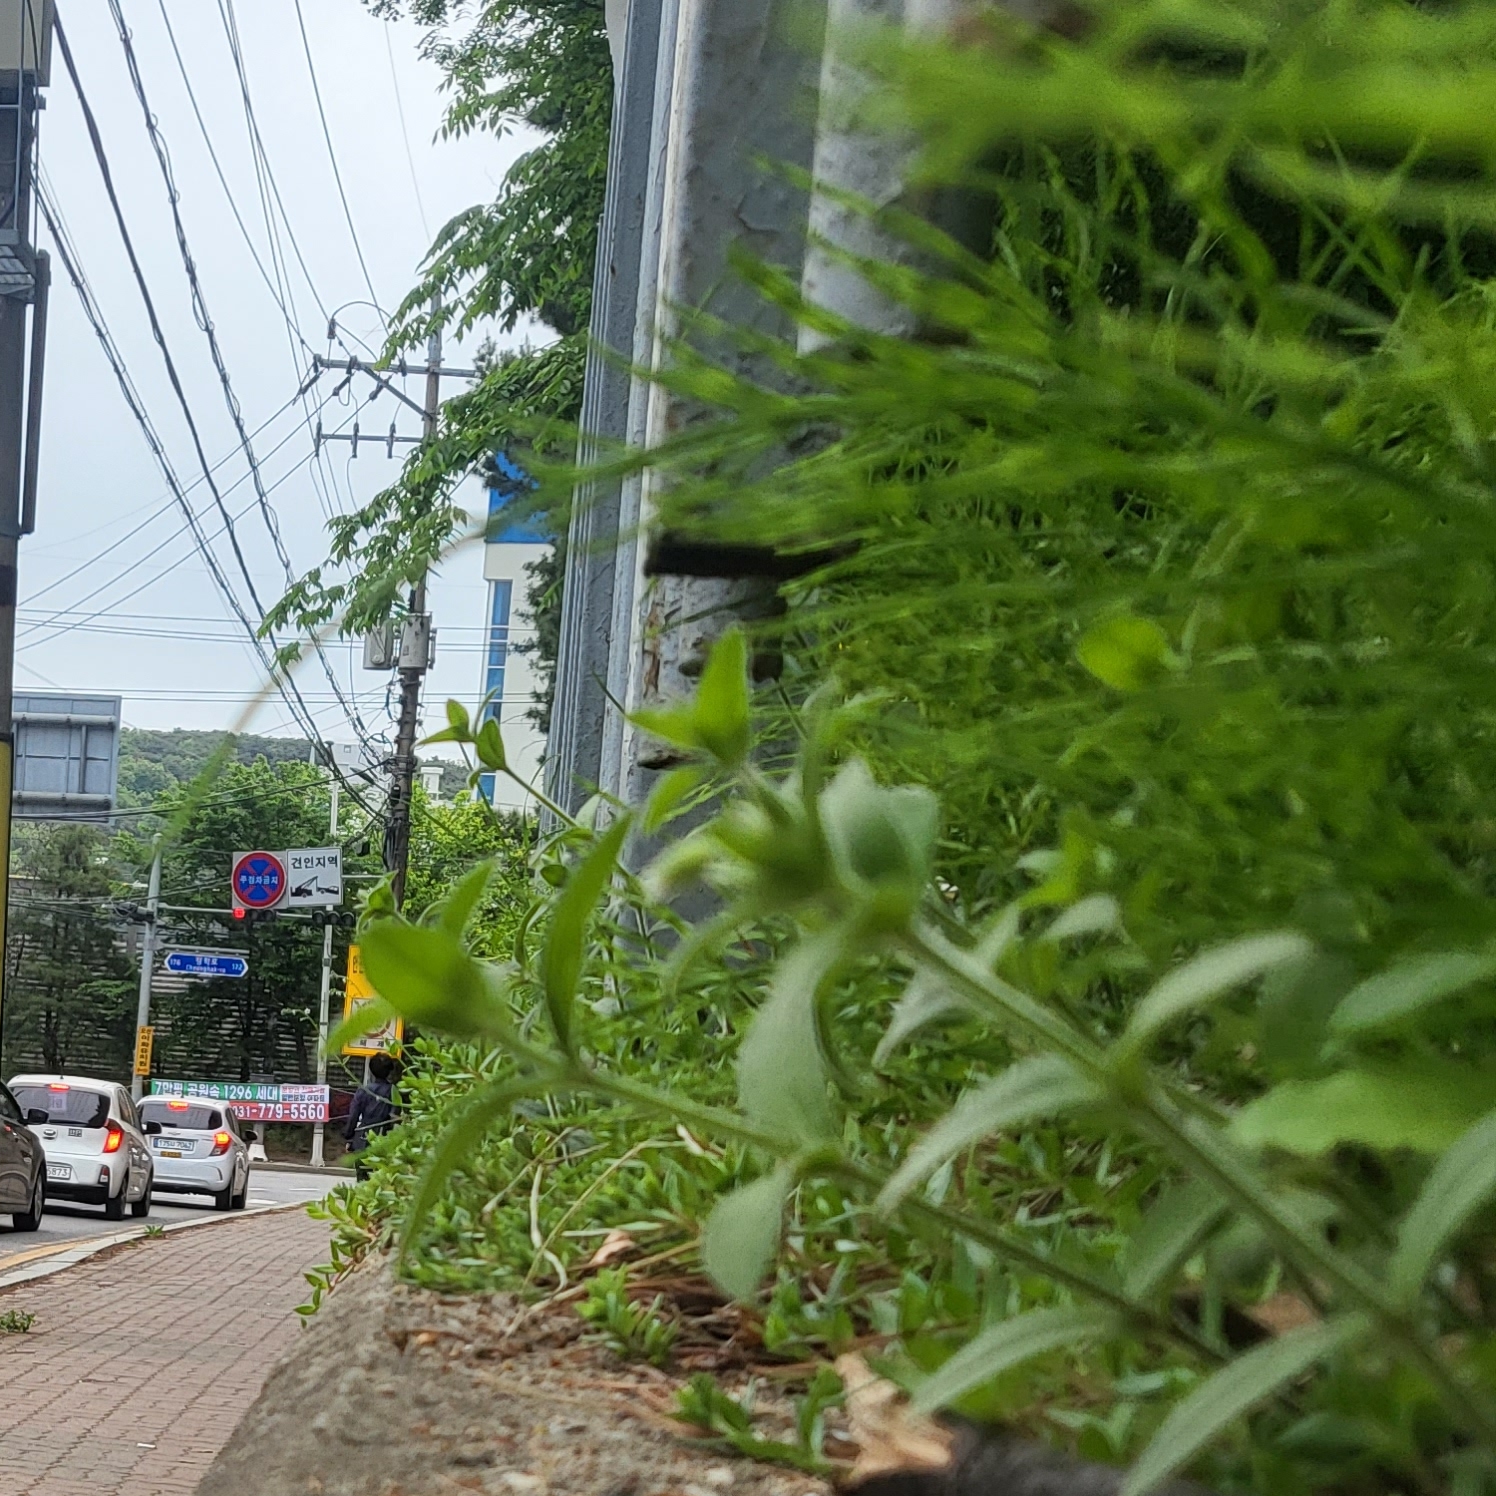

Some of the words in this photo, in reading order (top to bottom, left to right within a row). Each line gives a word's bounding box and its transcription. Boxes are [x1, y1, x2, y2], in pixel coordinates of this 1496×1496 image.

[291, 854, 338, 869] 견인지역
[154, 1081, 184, 1095] 7만평
[187, 1083, 220, 1098] 공원속
[223, 1085, 253, 1100] 1296
[255, 1085, 278, 1101] 세대
[232, 1102, 325, 1120] 031-779-5560
